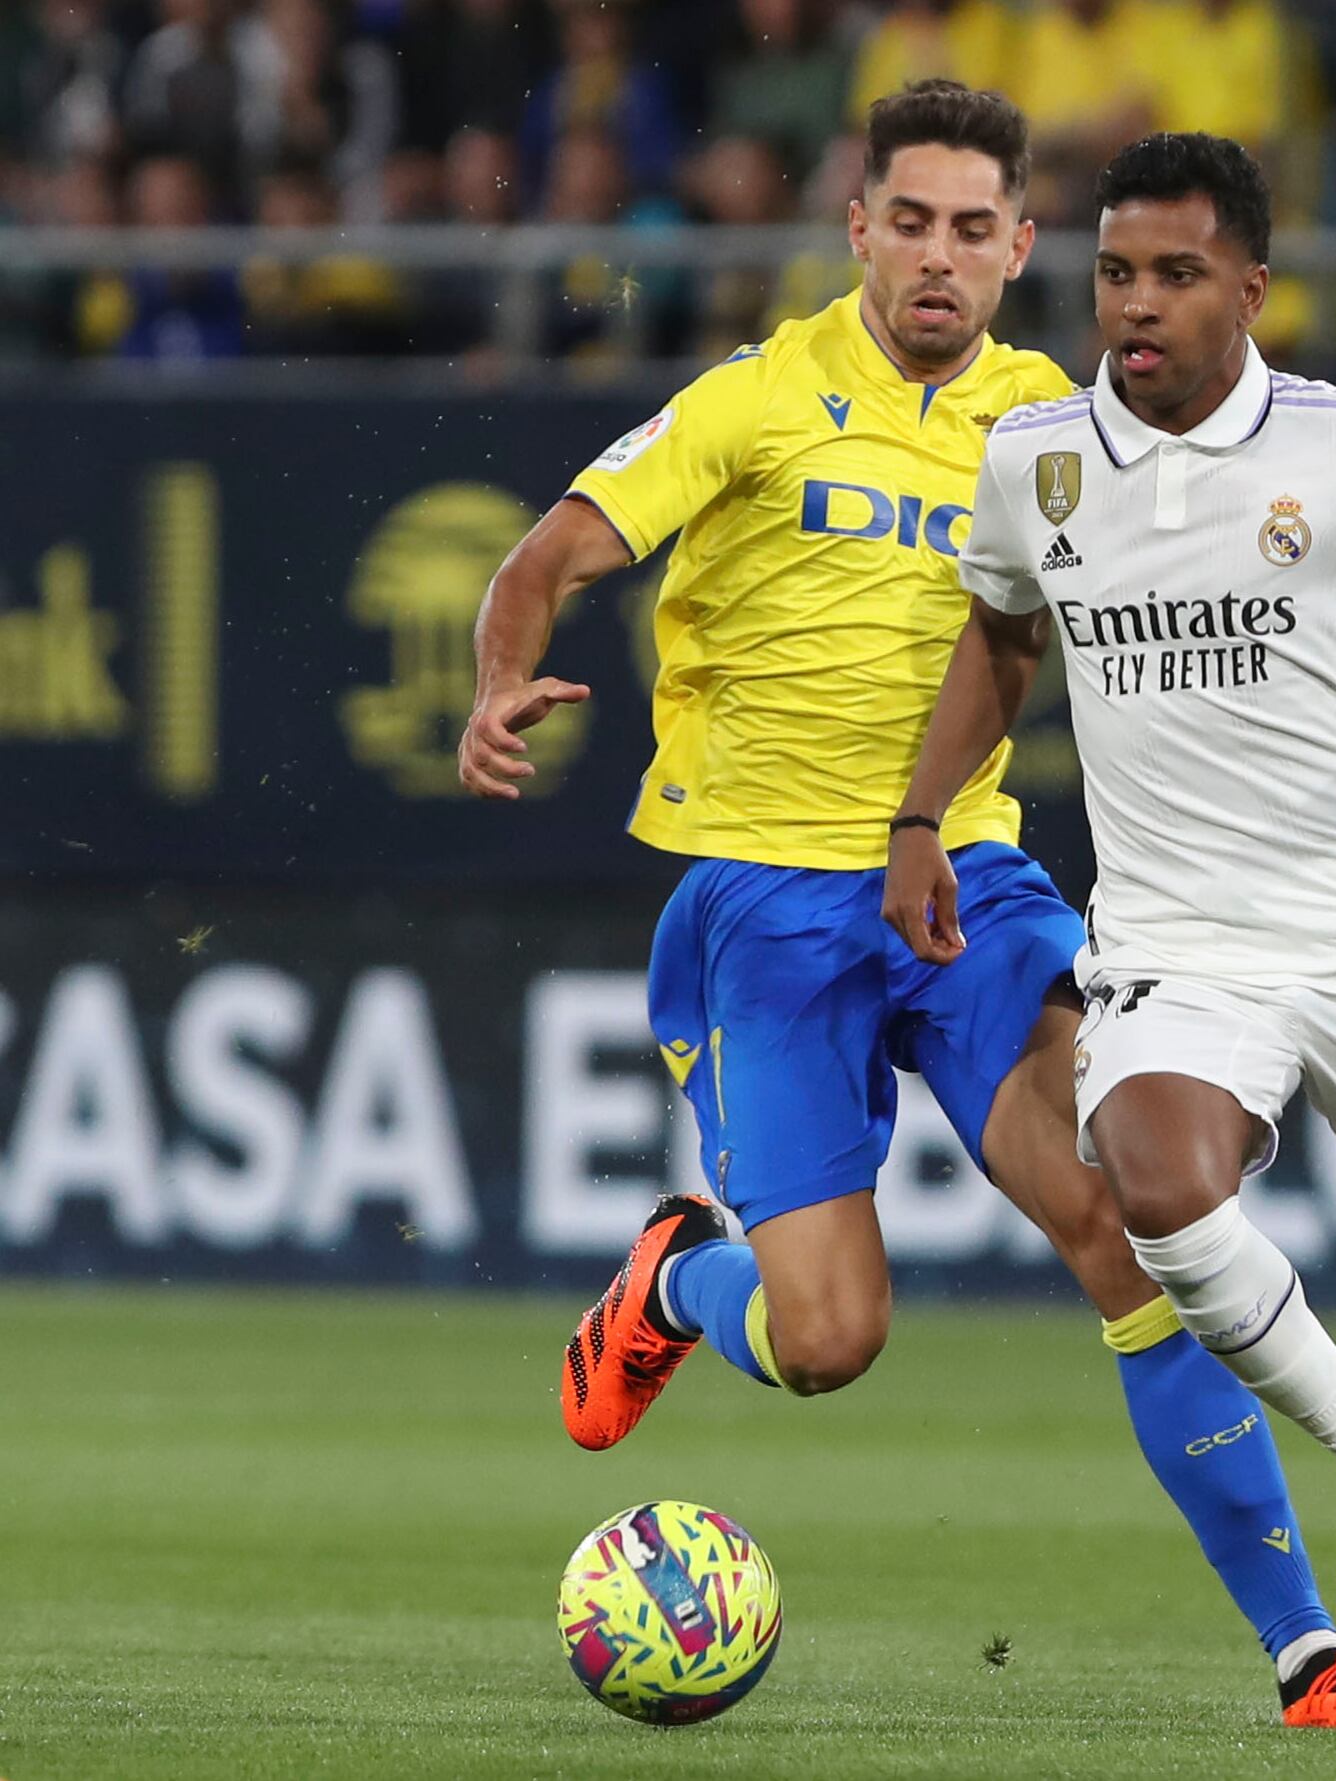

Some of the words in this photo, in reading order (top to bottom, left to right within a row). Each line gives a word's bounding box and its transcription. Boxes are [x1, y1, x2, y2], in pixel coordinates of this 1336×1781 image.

[1041, 554, 1082, 572] adidas
[1056, 589, 1297, 648] Emirates
[1102, 653, 1145, 696] FLY
[1160, 643, 1269, 692] BETTER
[0, 964, 476, 1250] ASA
[1185, 1413, 1259, 1457] CCF
